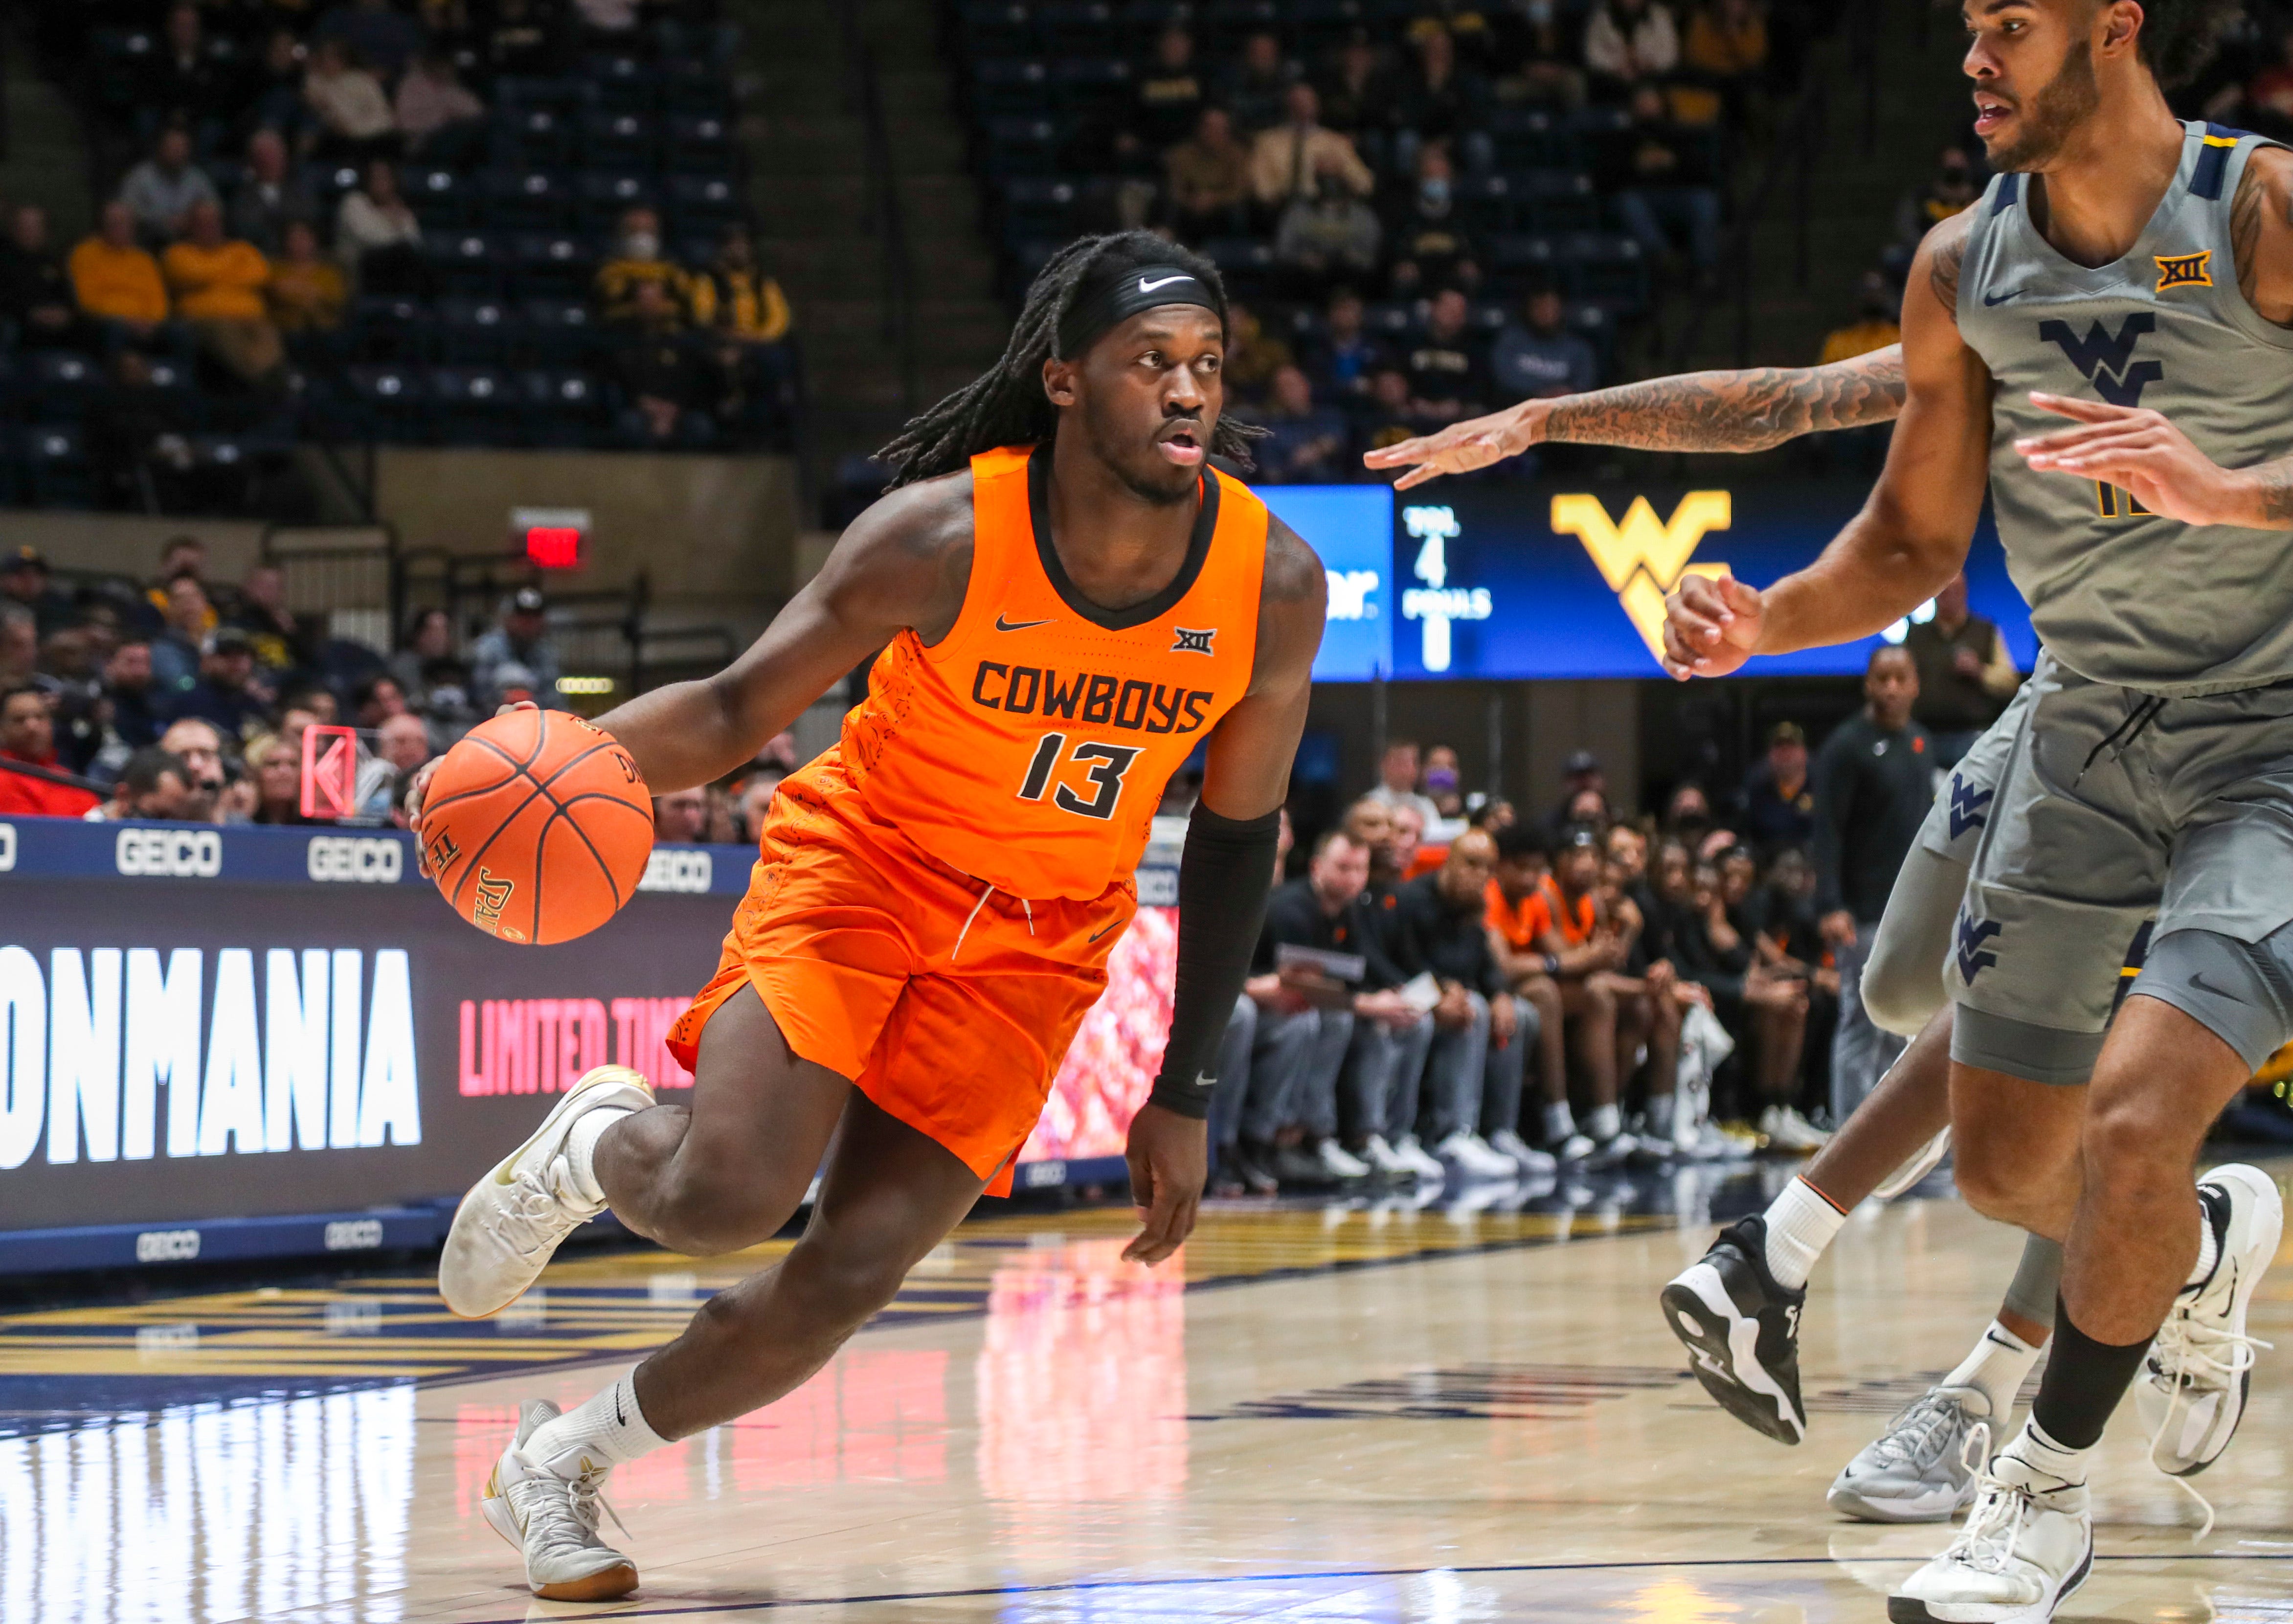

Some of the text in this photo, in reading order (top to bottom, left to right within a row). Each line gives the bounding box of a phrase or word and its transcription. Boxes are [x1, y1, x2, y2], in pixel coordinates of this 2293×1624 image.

[1414, 534, 1447, 588] 4
[1171, 628, 1215, 656] XII
[972, 660, 1214, 734] COWBOYS
[1017, 731, 1146, 820] 13
[116, 828, 222, 877] GEICO
[308, 836, 402, 882] GEICO
[460, 998, 607, 1096] LIMITED
